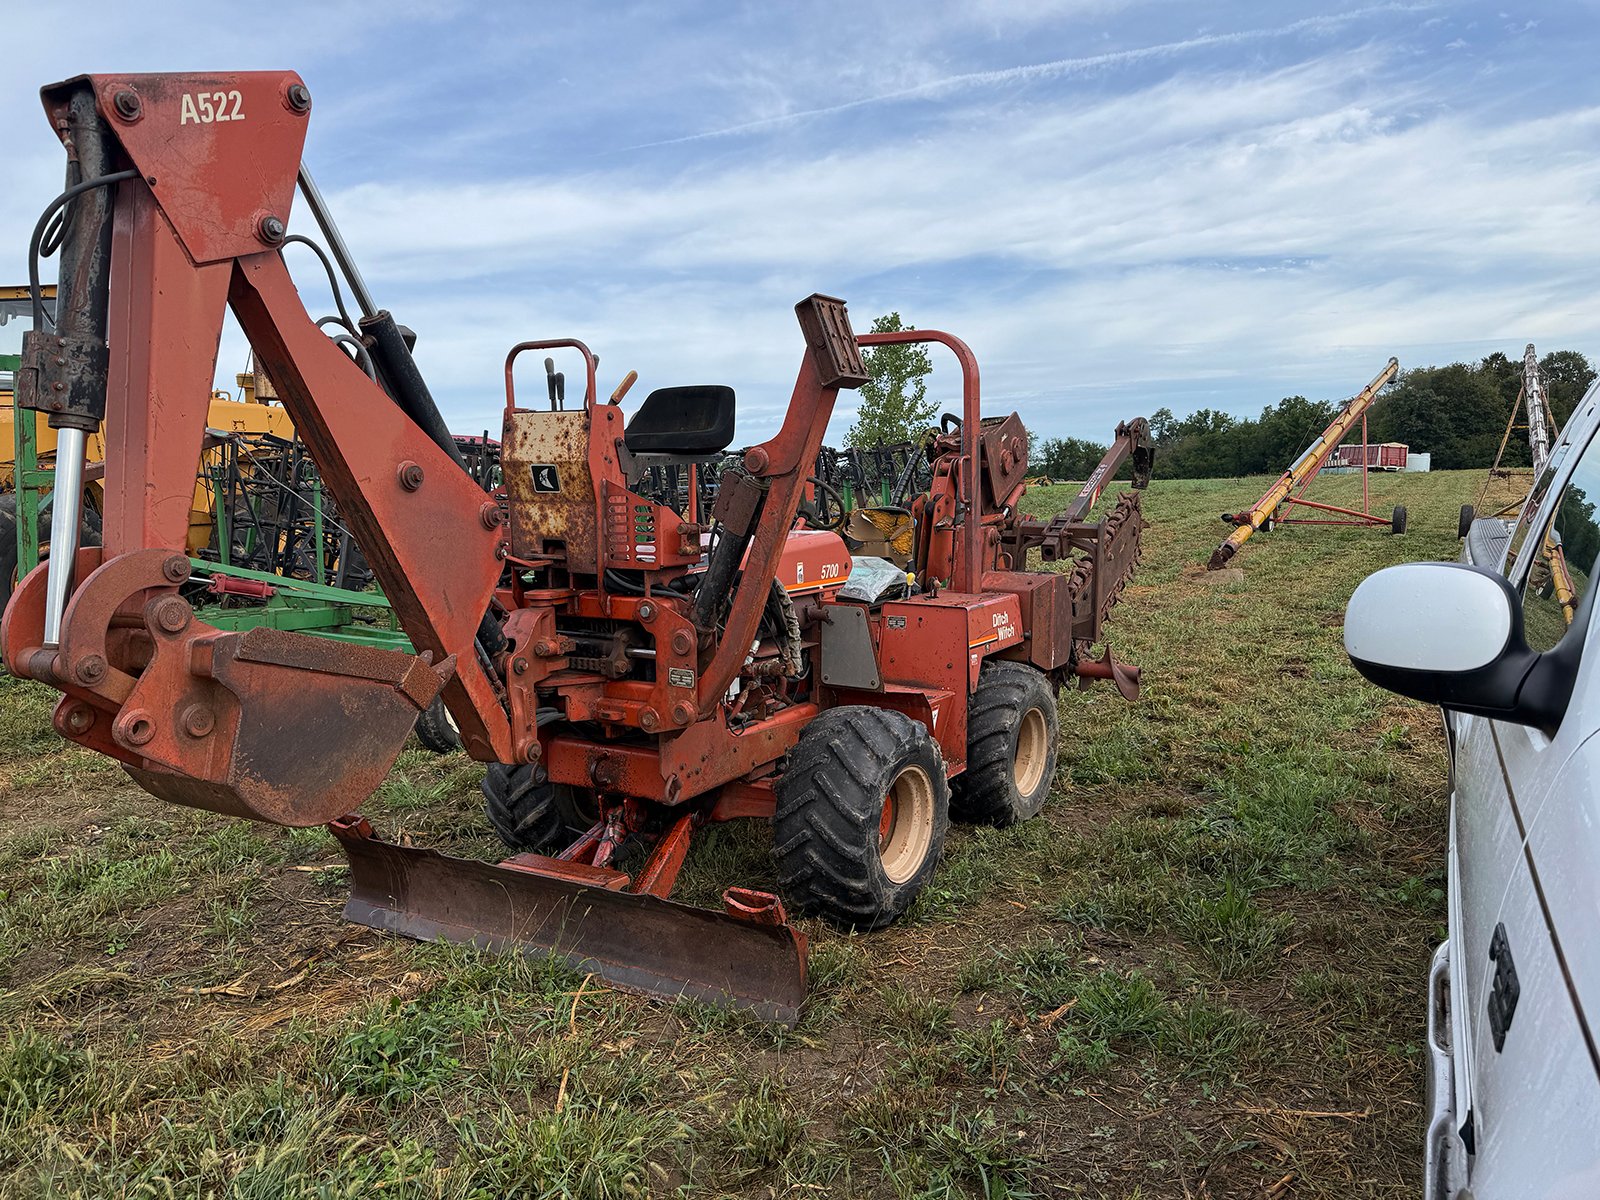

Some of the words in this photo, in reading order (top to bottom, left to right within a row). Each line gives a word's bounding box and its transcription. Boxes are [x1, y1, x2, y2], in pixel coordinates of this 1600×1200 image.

[180, 90, 245, 125] A522
[820, 563, 839, 580] 5700
[992, 611, 1009, 628] Ditch
[997, 624, 1015, 641] Witch
